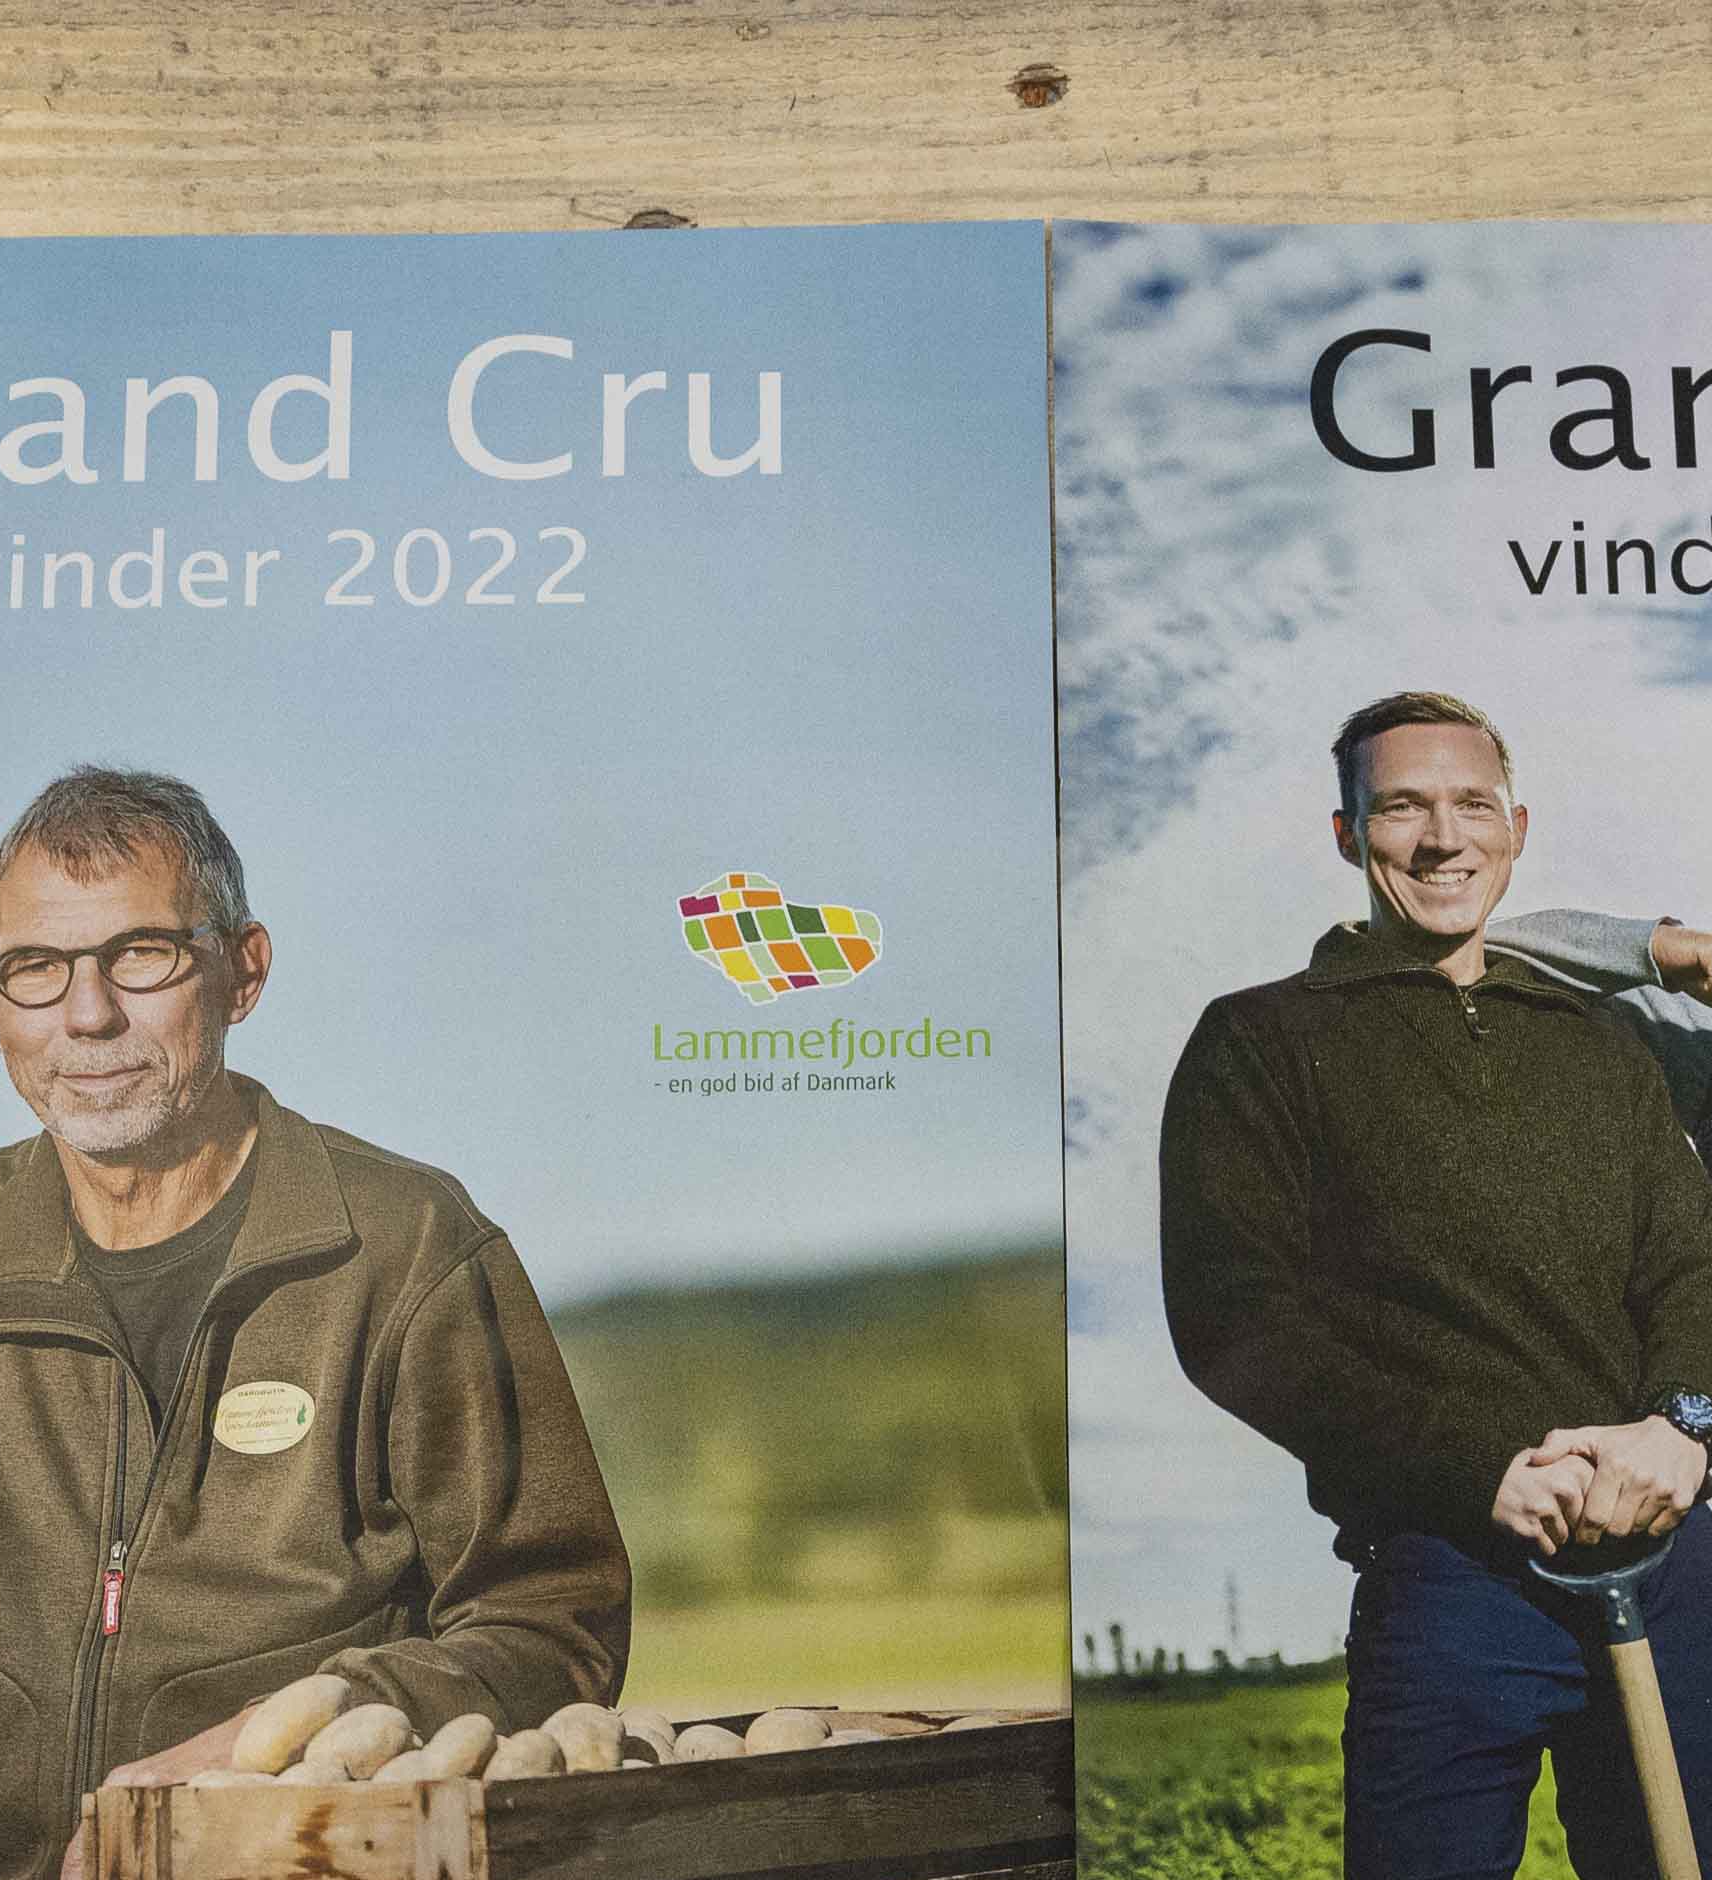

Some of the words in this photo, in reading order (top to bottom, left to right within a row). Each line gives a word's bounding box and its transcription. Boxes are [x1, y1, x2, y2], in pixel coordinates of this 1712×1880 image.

[446, 333, 783, 481] Cru
[324, 526, 588, 606] 2022
[653, 1017, 992, 1070] Lammefjorden
[668, 1077, 693, 1093] en
[701, 1072, 736, 1097] god
[744, 1071, 774, 1092] bid
[781, 1071, 799, 1092] af
[807, 1071, 896, 1092] Danmark
